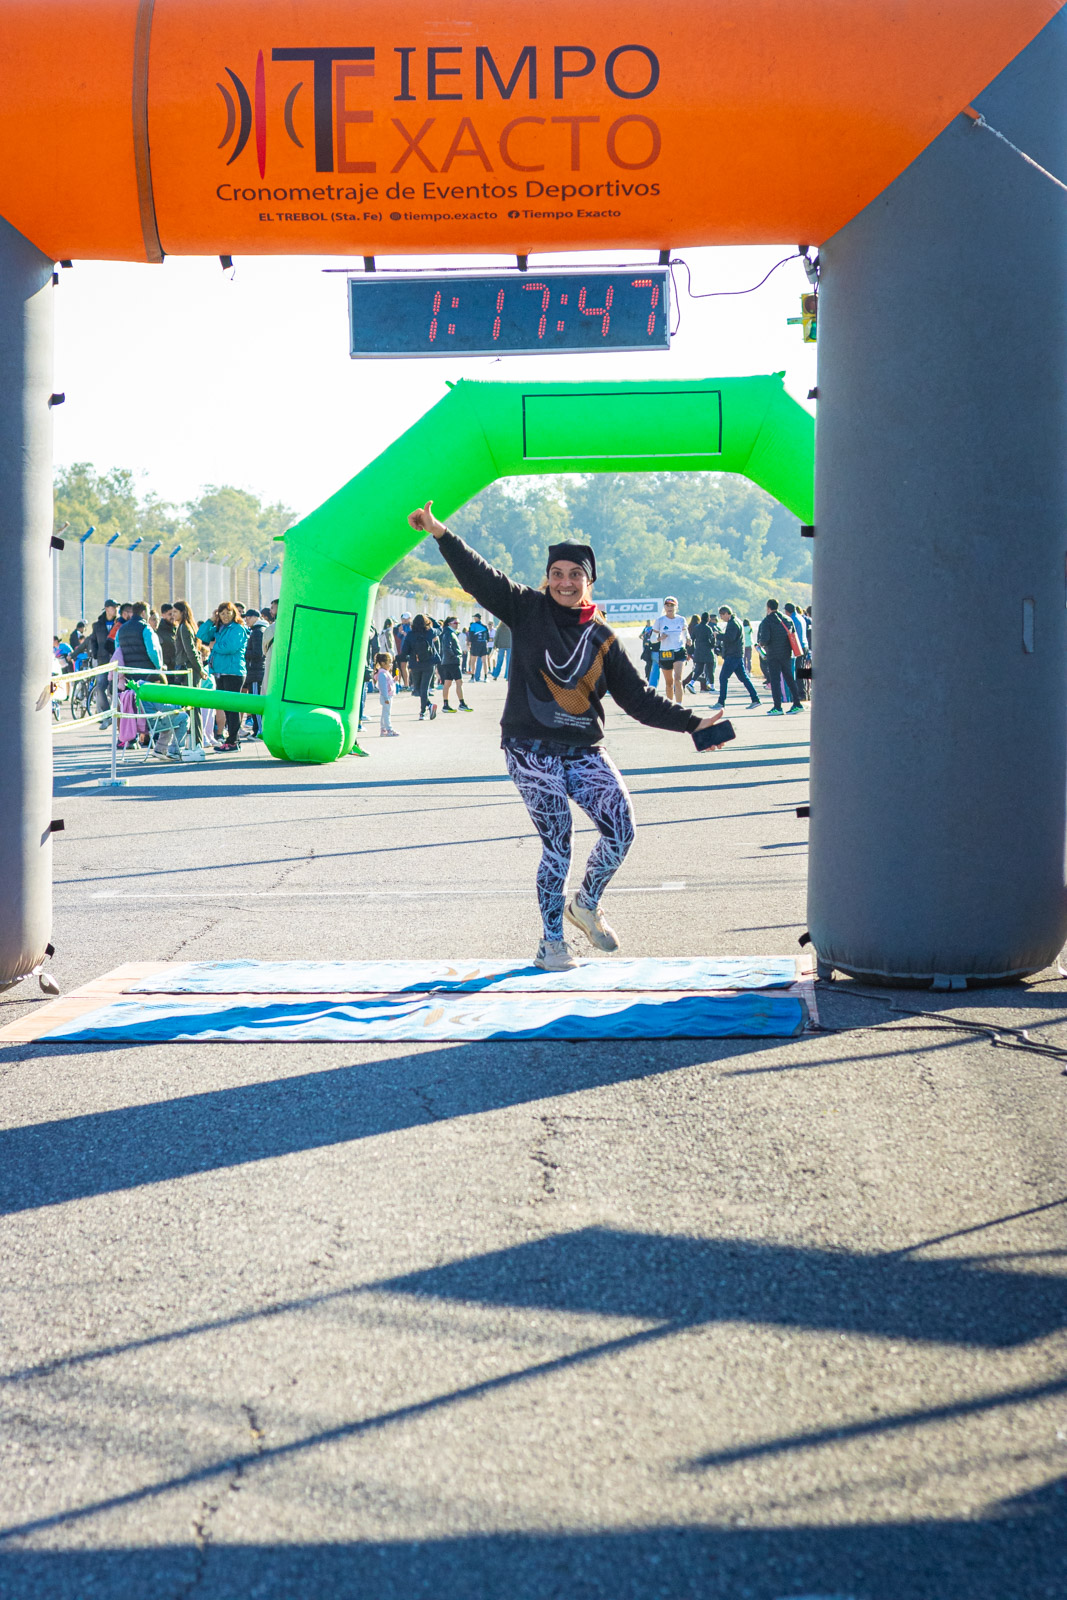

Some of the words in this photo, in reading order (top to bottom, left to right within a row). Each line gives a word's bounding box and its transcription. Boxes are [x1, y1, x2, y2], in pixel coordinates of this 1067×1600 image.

[216, 183, 379, 204] Cronometraje
[385, 182, 415, 200] de
[423, 182, 518, 199] Eventos
[526, 180, 661, 201] Deportivos
[258, 212, 274, 222] EL
[277, 212, 328, 222] TREBOL
[331, 211, 361, 222] (Sta.
[363, 211, 383, 222] Fe)
[403, 210, 498, 222] tiempo.exacto
[522, 209, 574, 220] Tiempo
[576, 208, 622, 219] Exacto
[609, 604, 655, 612] LONG
